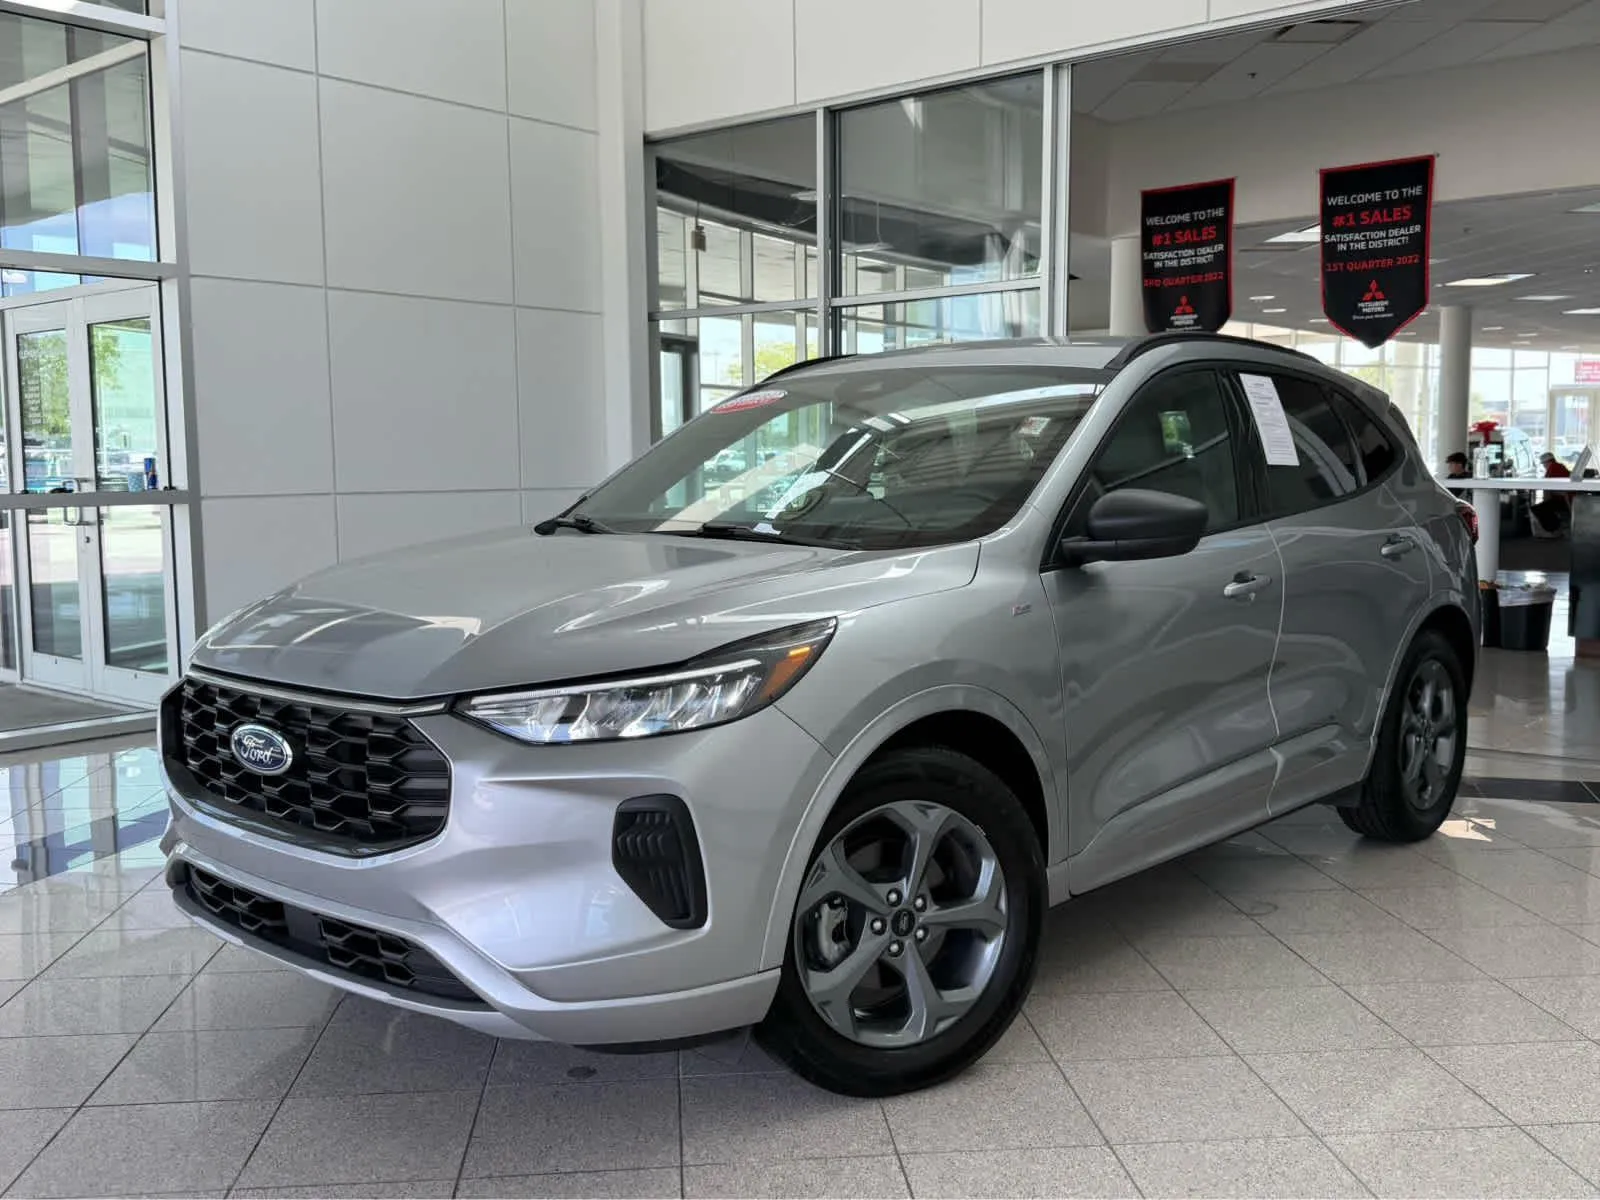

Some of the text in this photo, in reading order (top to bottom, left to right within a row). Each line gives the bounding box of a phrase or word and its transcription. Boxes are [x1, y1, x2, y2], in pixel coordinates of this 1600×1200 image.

[1327, 185, 1423, 206] WELCOME TO THE
[1145, 207, 1225, 226] WELCOME TO THE
[1332, 205, 1413, 228] #1 SALES
[1152, 225, 1217, 247] #1 SALES
[1324, 224, 1421, 243] SATISFACTION DEALER
[1143, 243, 1224, 260] SATISFACTION DEALER
[1337, 236, 1409, 252] IN THE DISTRICT!
[1154, 260, 1163, 269] IN
[1164, 259, 1179, 268] THE
[1326, 255, 1420, 272] 1ST QUARTER 2022
[1162, 274, 1204, 287] QUARTER
[241, 734, 279, 764] Ford
